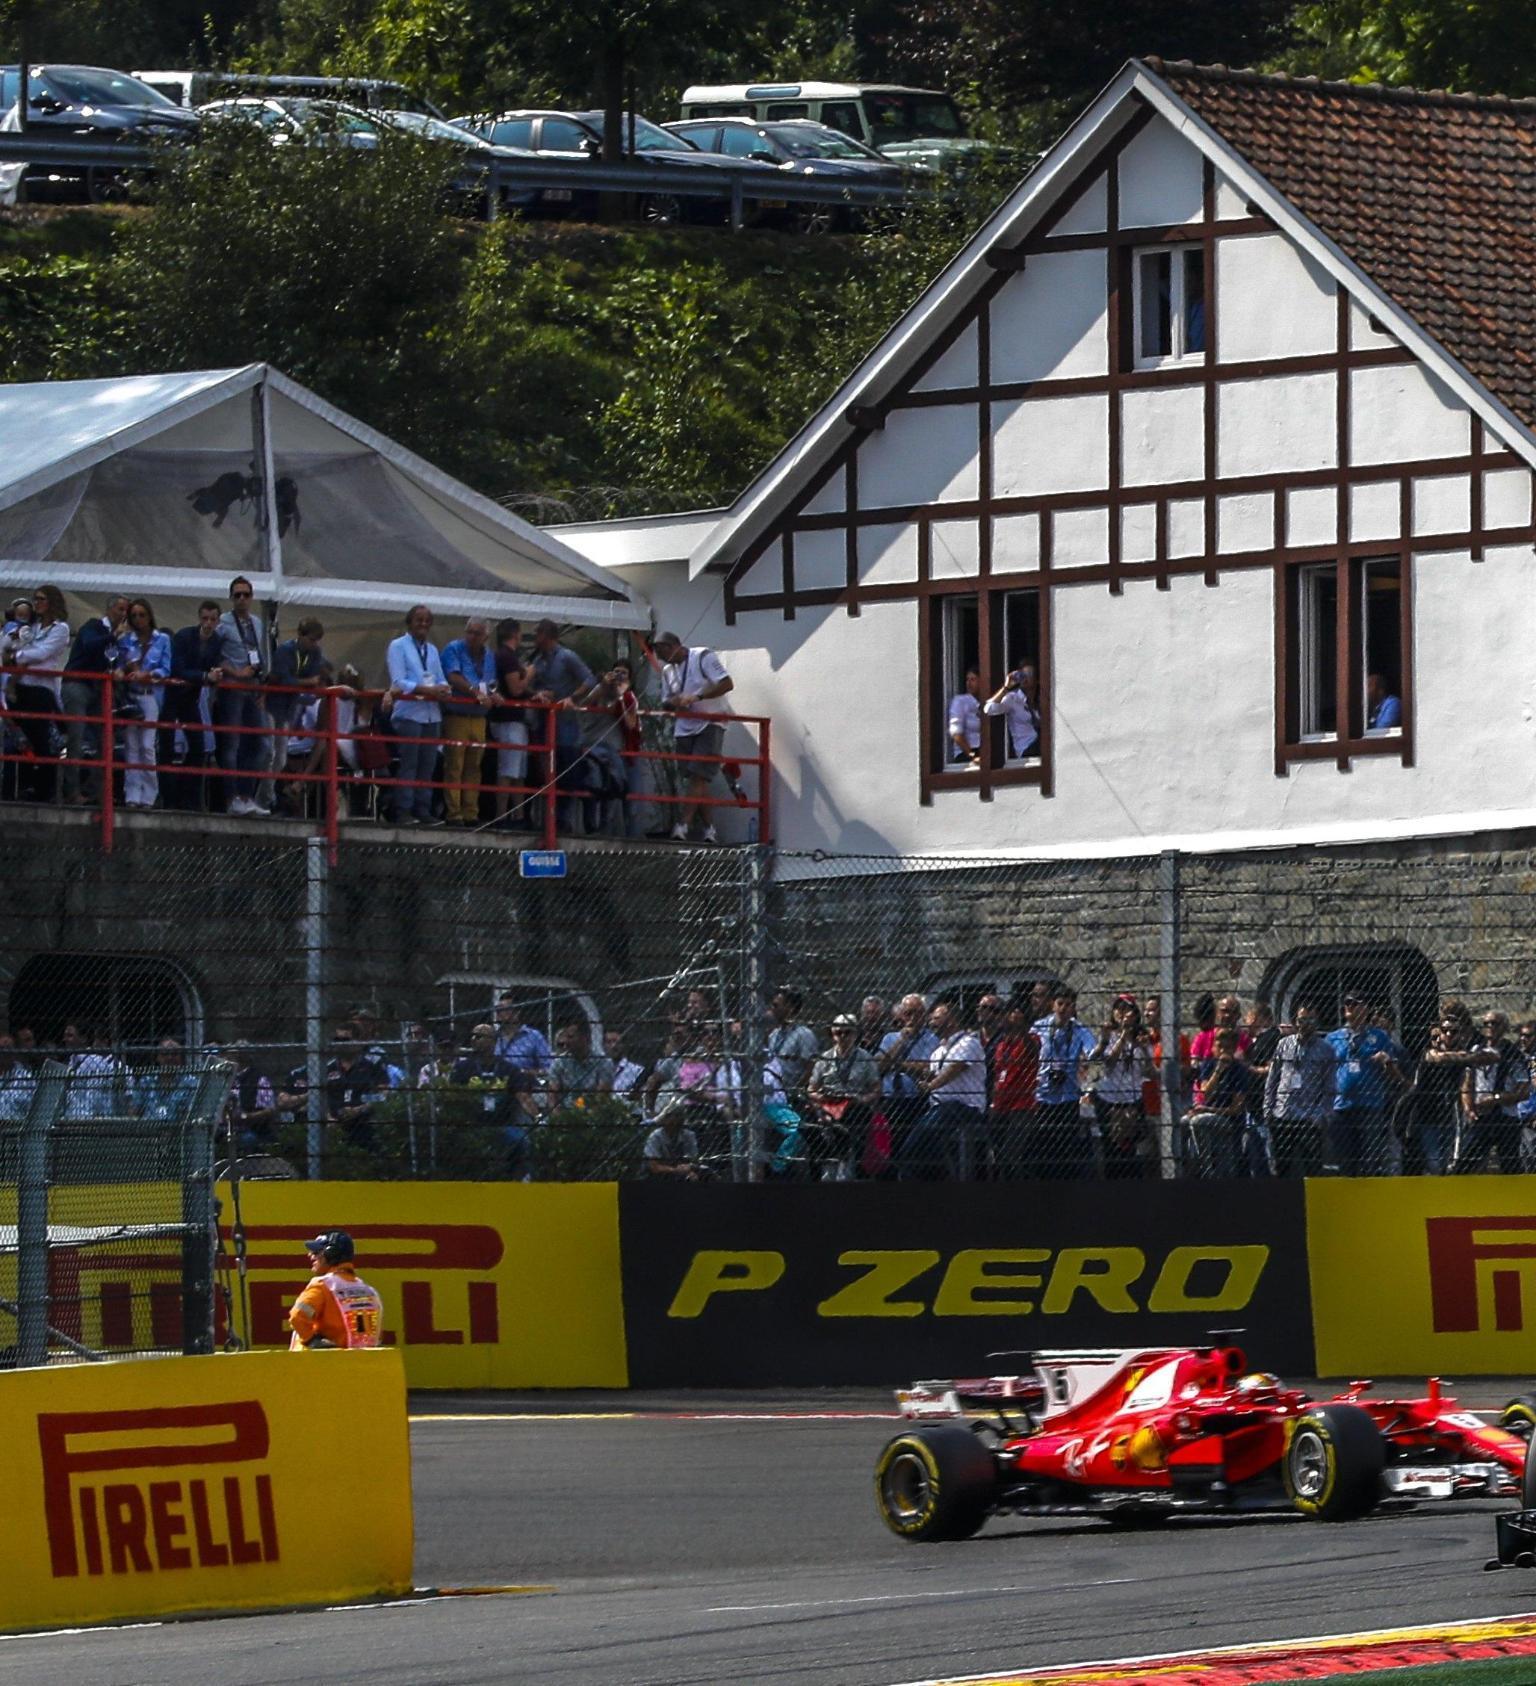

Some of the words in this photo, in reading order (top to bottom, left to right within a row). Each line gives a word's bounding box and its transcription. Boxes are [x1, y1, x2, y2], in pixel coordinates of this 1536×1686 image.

[48, 1223, 504, 1346] PIRELI
[667, 1250, 787, 1318] P
[817, 1245, 1269, 1317] ZERO
[37, 1399, 280, 1578] PIRELLI
